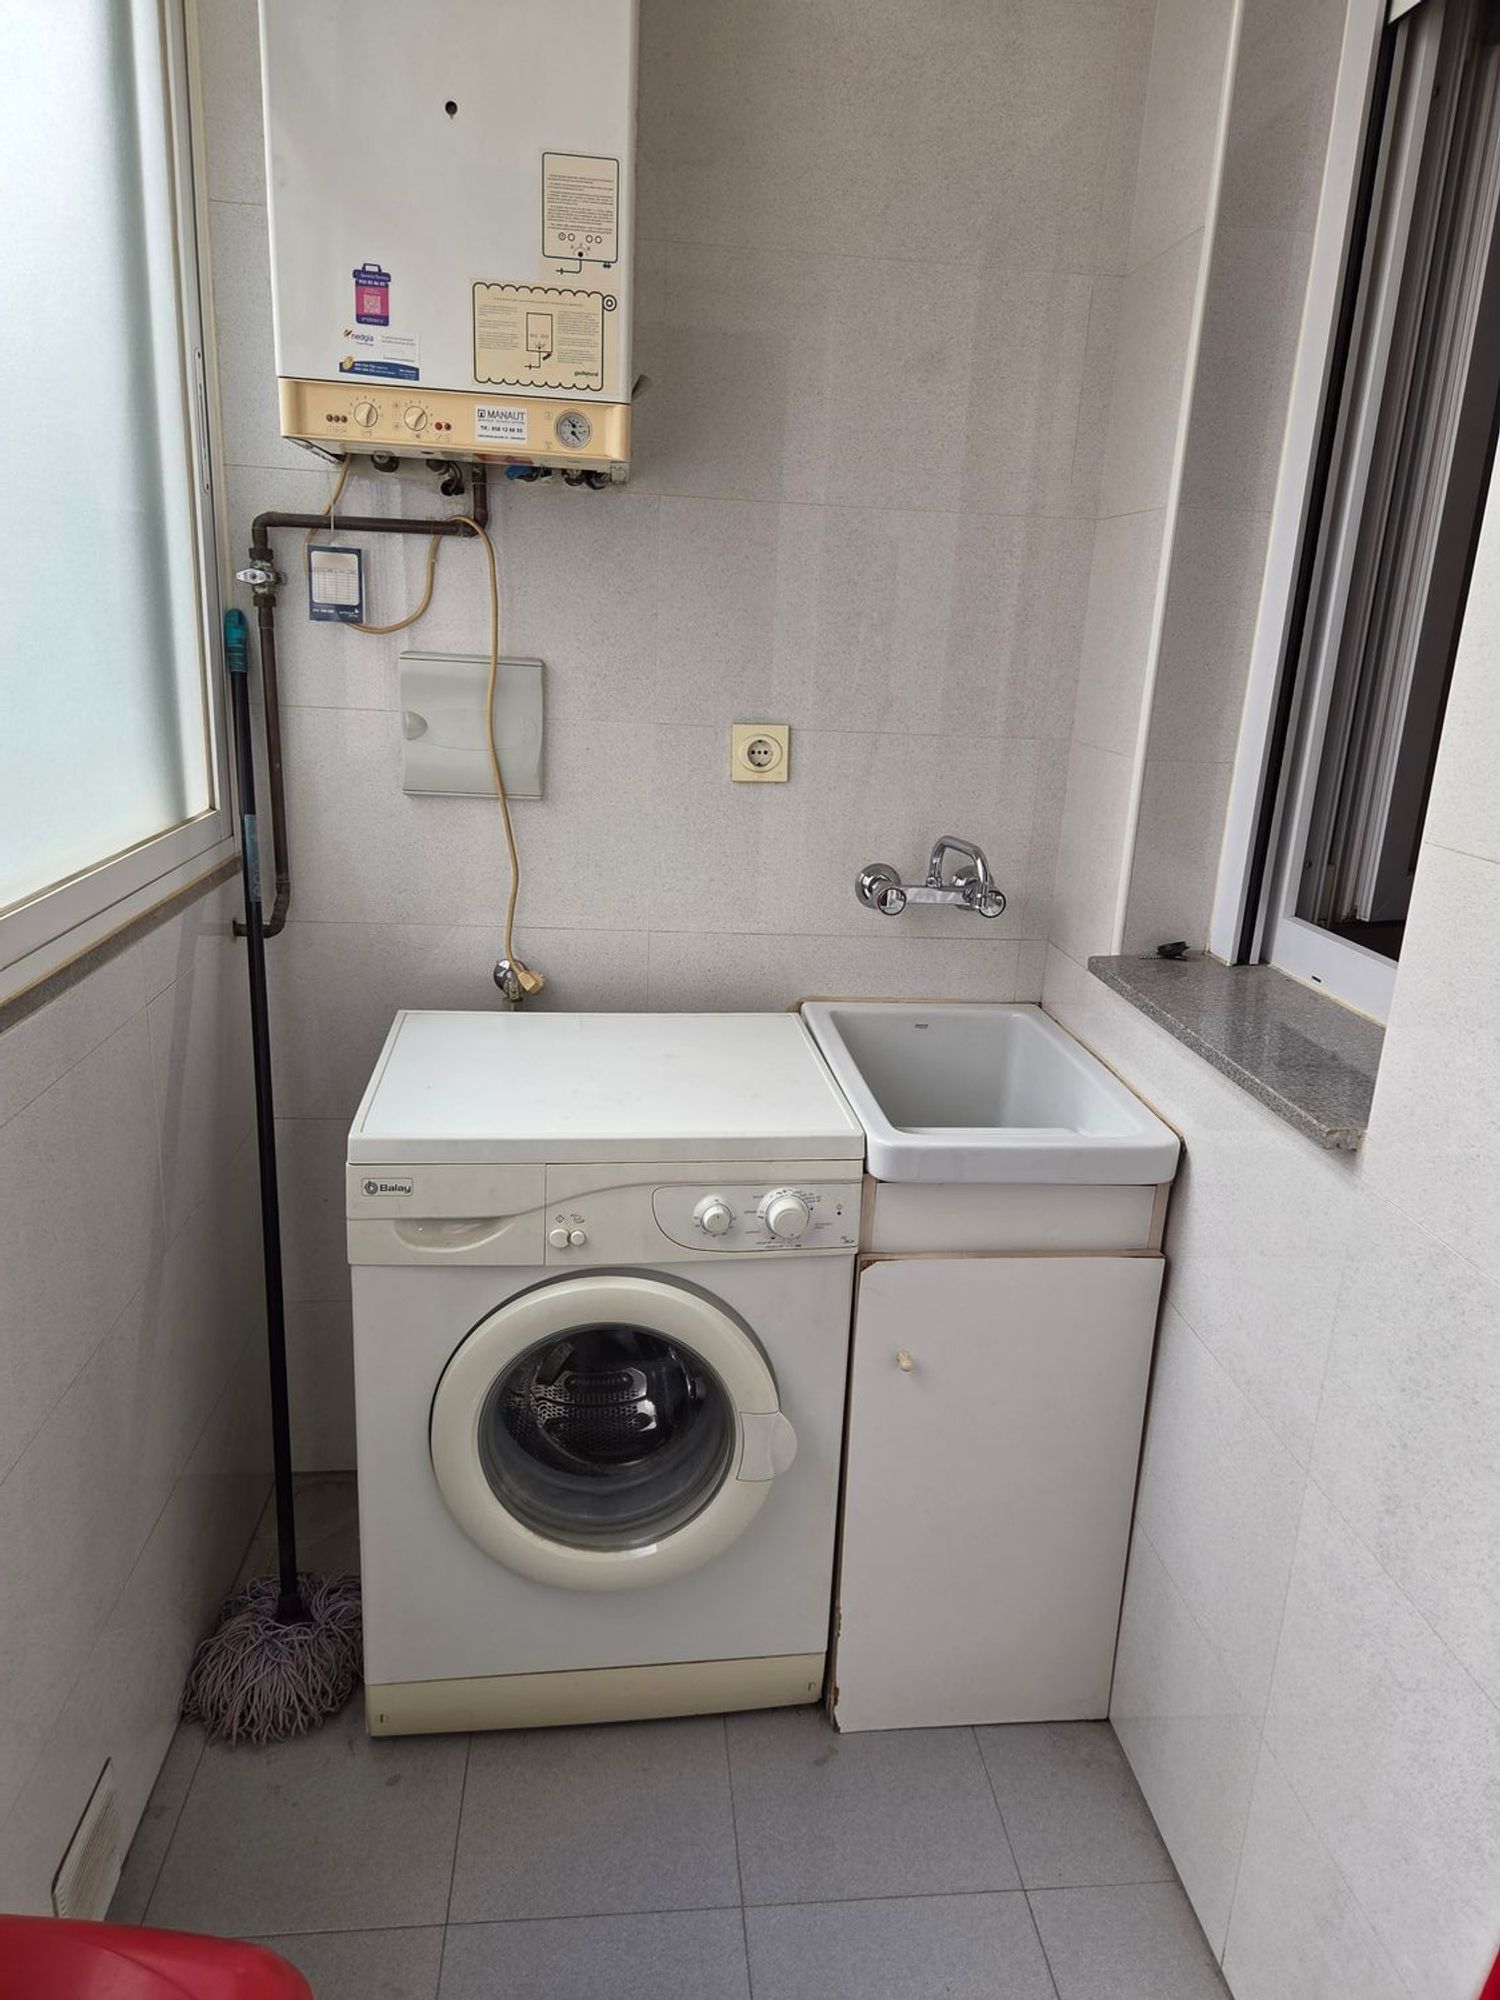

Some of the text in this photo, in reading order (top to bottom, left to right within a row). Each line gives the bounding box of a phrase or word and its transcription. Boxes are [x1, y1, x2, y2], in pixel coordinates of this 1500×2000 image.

[351, 333, 374, 342] nedgia
[487, 410, 525, 420] MANAUT
[380, 1184, 411, 1194] Balay
